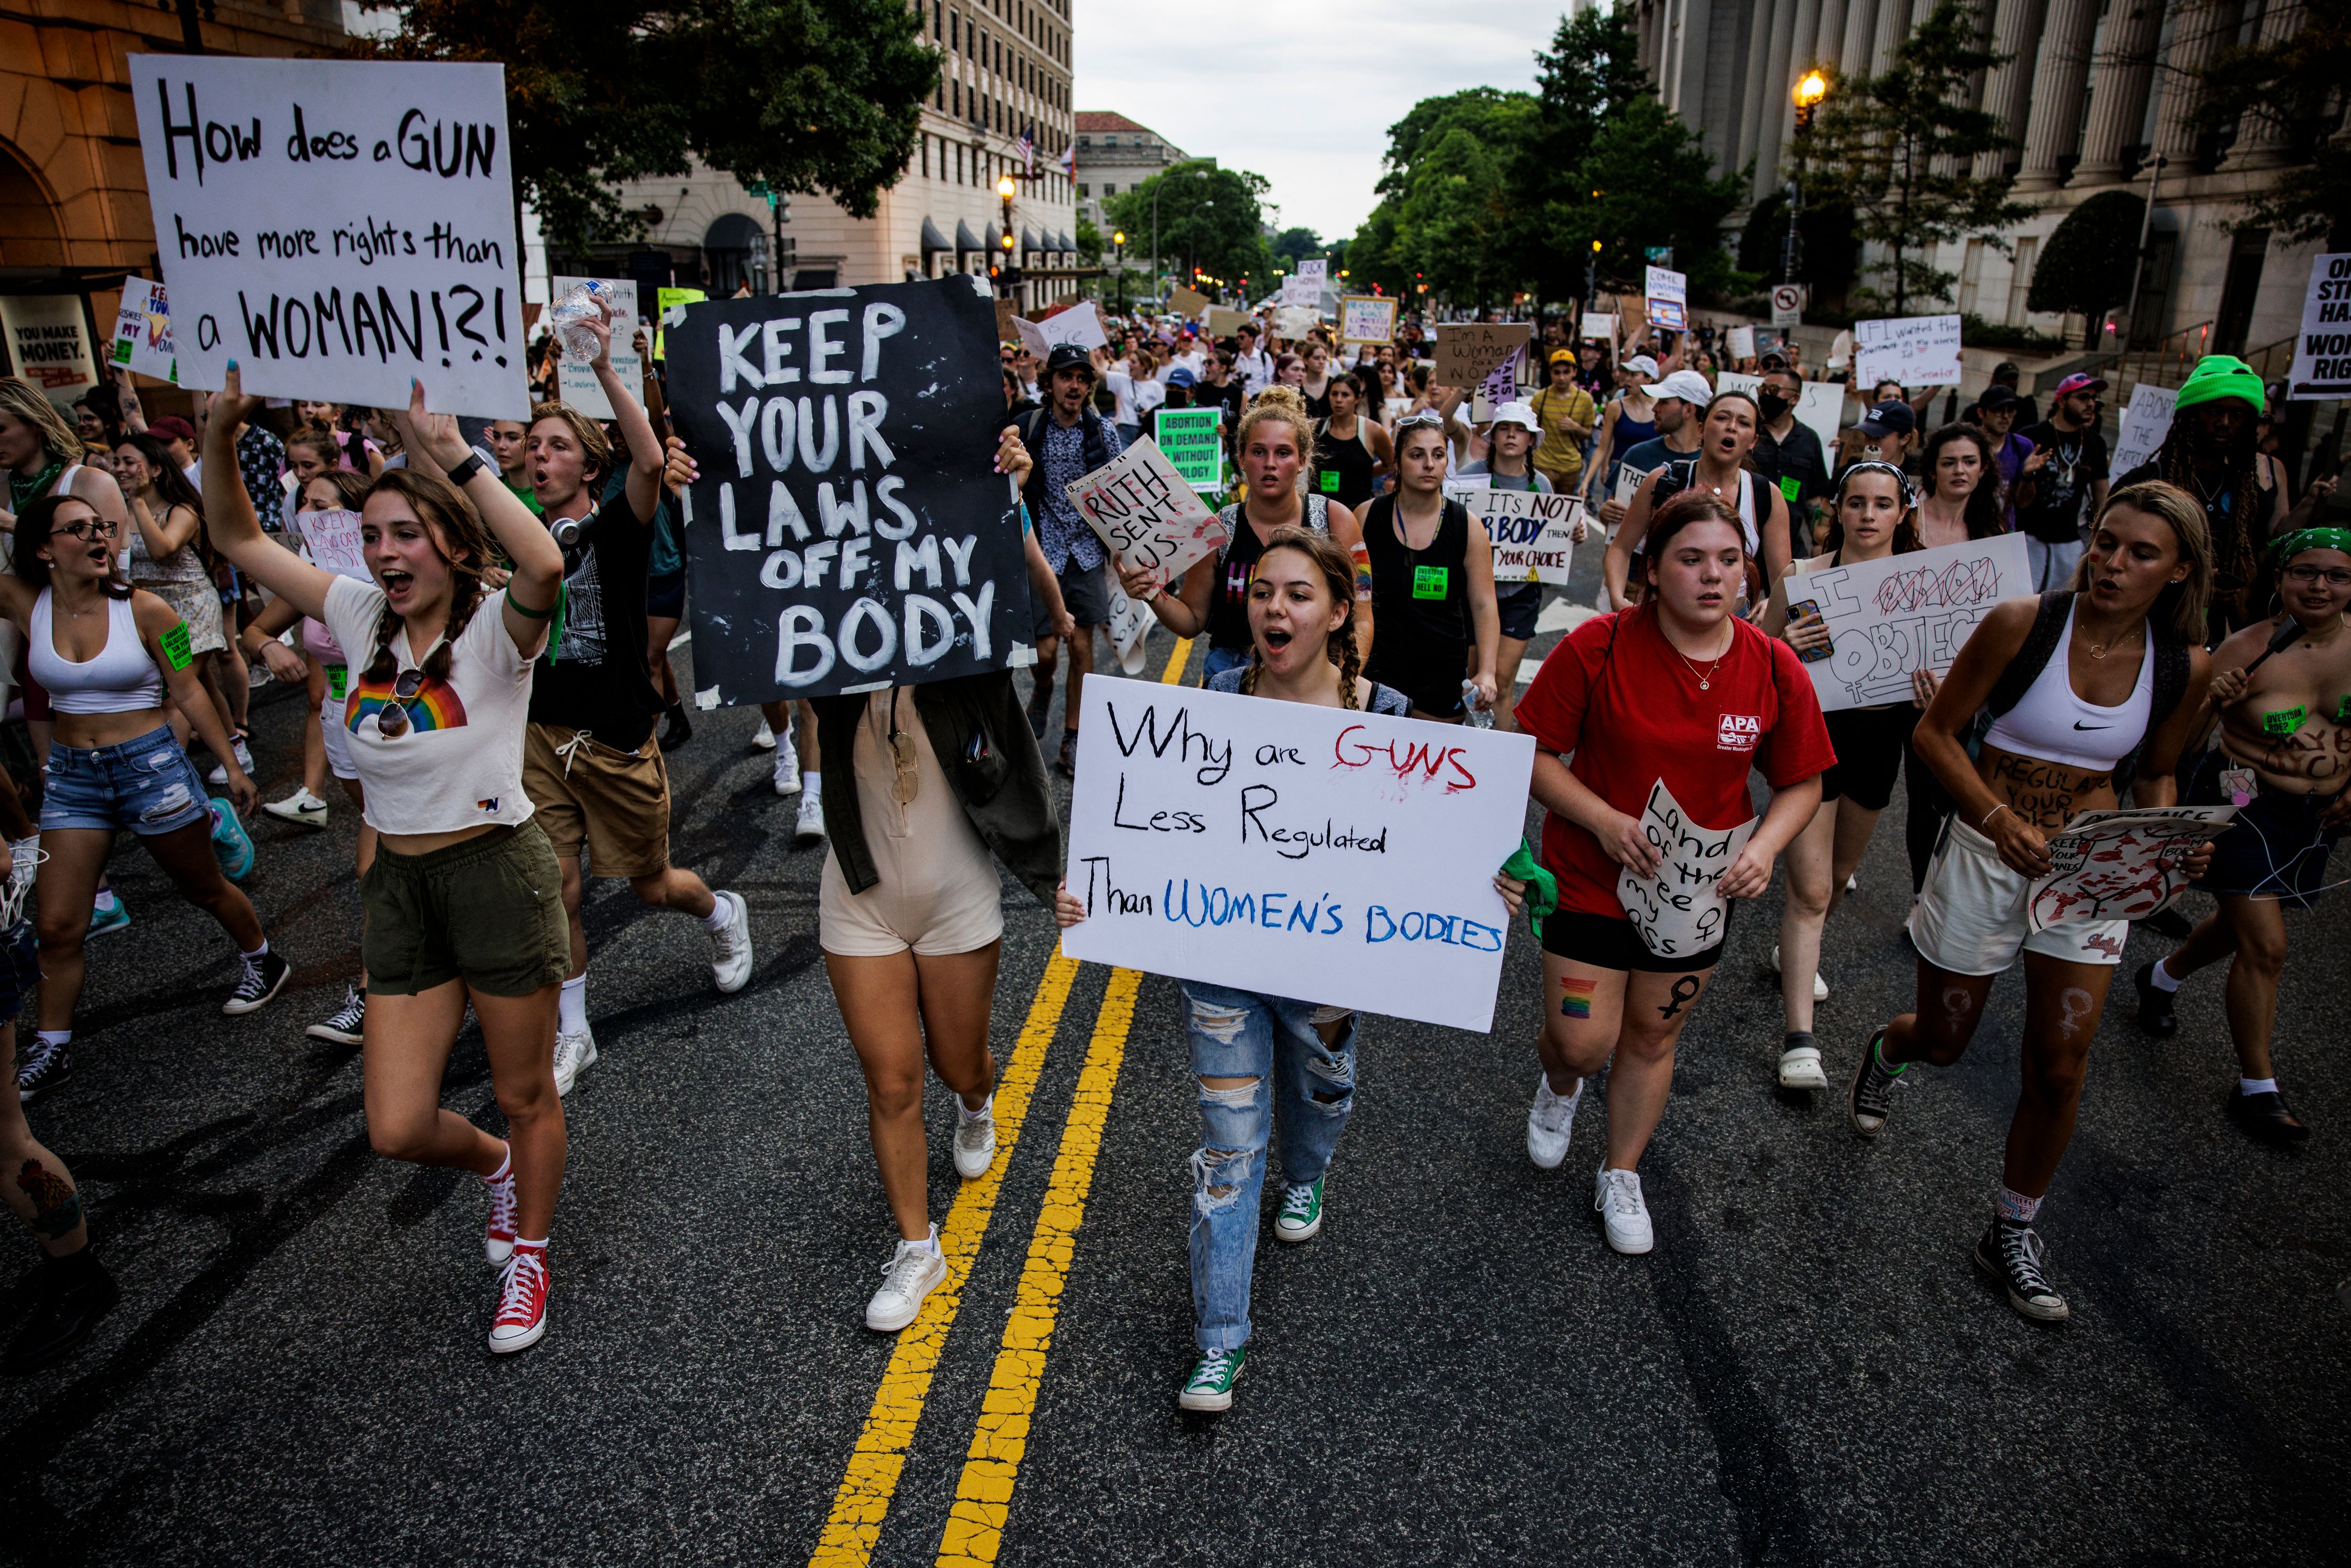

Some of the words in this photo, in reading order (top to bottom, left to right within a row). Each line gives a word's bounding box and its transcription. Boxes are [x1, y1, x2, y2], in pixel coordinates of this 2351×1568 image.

[287, 103, 359, 162] does
[374, 135, 392, 161] a
[397, 108, 496, 178] GUN
[174, 214, 240, 260] have
[258, 223, 320, 259] more
[333, 215, 416, 266] rights
[424, 221, 503, 270] than
[1300, 262, 1323, 274] FUCK
[1650, 270, 1678, 284] COME
[150, 284, 168, 300] KE
[150, 298, 170, 316] YOU
[2319, 303, 2351, 322] HA
[15, 327, 40, 340] YOU
[42, 326, 78, 339] MAKE
[122, 323, 141, 338] MY
[198, 314, 221, 351] a
[238, 284, 508, 368] WOMAN!?!
[1483, 330, 1494, 343] A
[18, 342, 84, 363] MONEY.
[719, 303, 905, 393] KEEP
[1453, 343, 1513, 358] Woman
[1900, 368, 1908, 380] A
[568, 379, 596, 392] Loving
[1477, 380, 1487, 398] DY
[1488, 384, 1498, 404] MY
[1166, 416, 1212, 429] ABORTION
[716, 390, 897, 478] YOUR
[1161, 435, 1173, 446] ON
[1177, 433, 1217, 446] DEMAND
[2132, 425, 2154, 446] THE
[1173, 449, 1215, 462] WITHOUT
[2115, 447, 2150, 467] PATRI
[1178, 465, 1209, 478] OLOGY
[1085, 460, 1170, 525] RUTH
[719, 475, 917, 551] LAWS
[1454, 492, 1474, 508] IF
[1531, 494, 1582, 521] NOT
[309, 512, 345, 532] KEEP
[1110, 493, 1177, 551] SENT
[1498, 515, 1548, 545] BODY
[1546, 529, 1570, 538] THEN
[309, 534, 338, 549] LAWS
[340, 531, 358, 547] OFF
[319, 548, 364, 569] BOD
[1135, 533, 1184, 570] US.
[1498, 550, 1524, 566] YOUR
[1526, 550, 1566, 568] CHOICE
[760, 536, 871, 590] OFF
[894, 534, 977, 590] MY
[1416, 583, 1431, 591] HELL
[1433, 584, 1445, 593] NO!
[1810, 569, 1861, 621] I
[775, 580, 995, 688] BODY
[171, 644, 180, 653] SIN
[1721, 716, 1759, 731] APA
[2266, 707, 2302, 724] OVERTURN
[2268, 722, 2289, 731] ROE?
[1108, 701, 1232, 785] Why
[1255, 744, 1306, 765] are
[1330, 725, 1476, 792] GUNS
[1994, 755, 2109, 795] REGULATE
[2006, 784, 2072, 813] YOUR
[1114, 772, 1207, 833] Less
[1241, 784, 1386, 859] Regulated
[1646, 784, 1734, 858] Land
[2050, 837, 2087, 849] KEEP
[2164, 846, 2194, 857] BOD
[2189, 839, 2209, 847] MY
[2050, 846, 2081, 861] YOUR
[1673, 862, 1727, 886] the
[1081, 857, 1153, 917] Than
[1163, 879, 1344, 936] WOMEN'S
[1367, 905, 1503, 953] BODIES
[1626, 878, 1659, 923] my
[1626, 908, 1677, 955] ass
